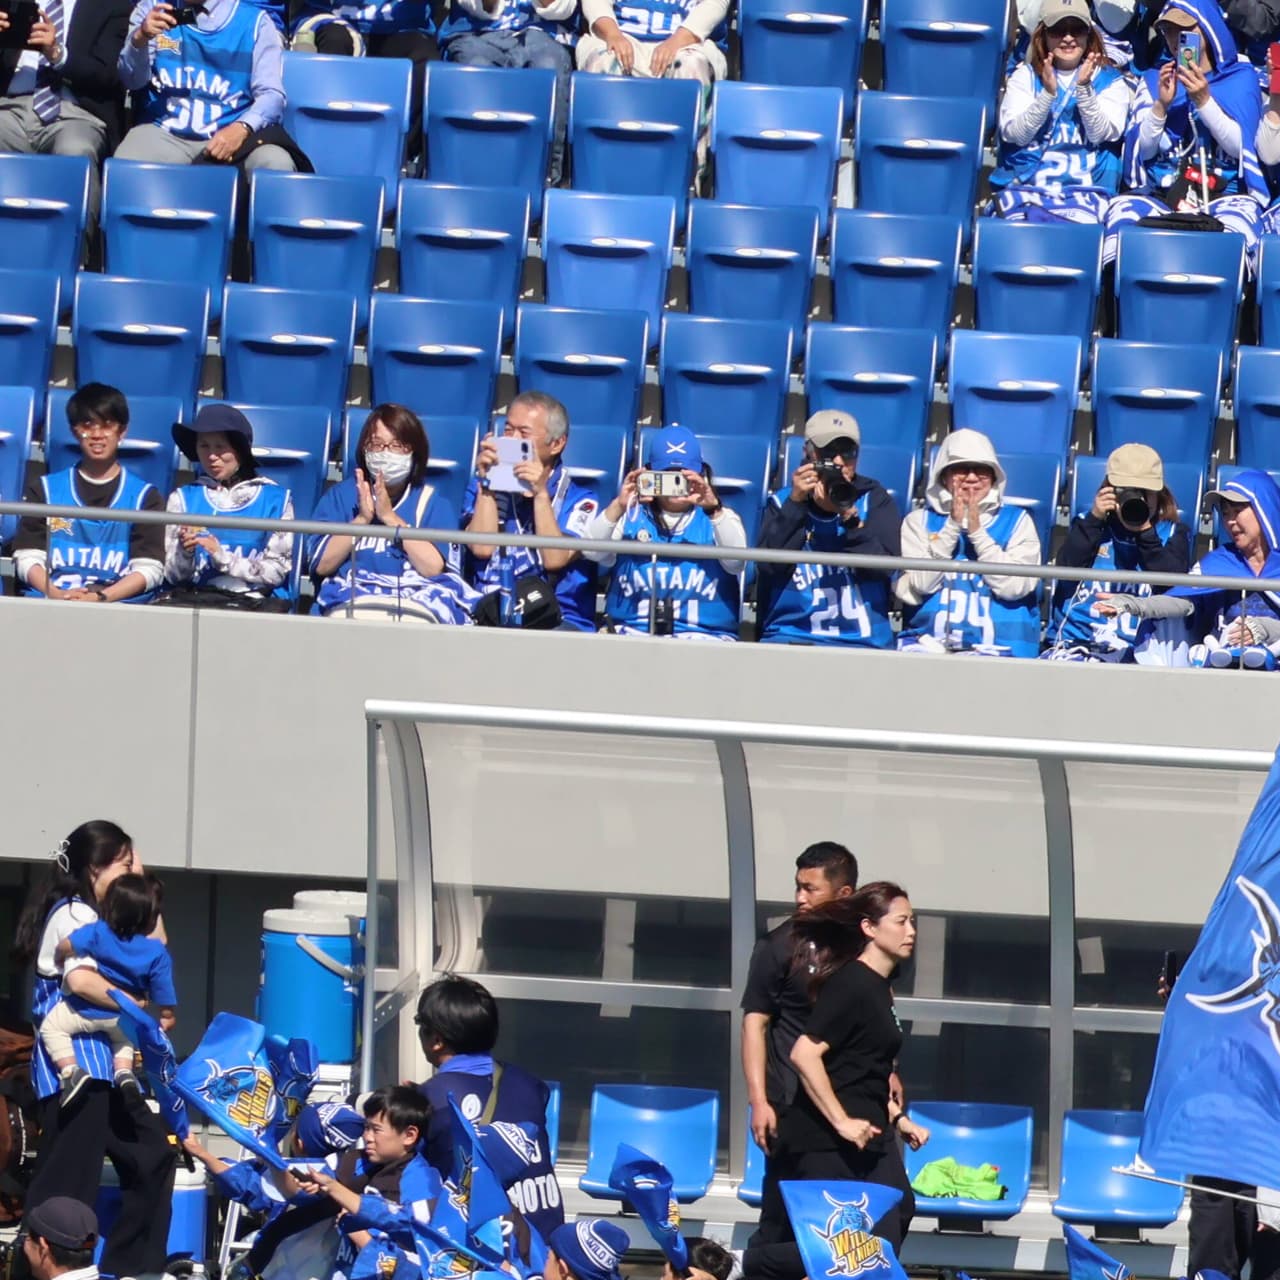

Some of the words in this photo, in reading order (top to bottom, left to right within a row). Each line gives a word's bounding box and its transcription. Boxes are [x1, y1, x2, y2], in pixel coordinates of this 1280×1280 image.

[1035, 151, 1096, 193] 24
[51, 546, 125, 573] AITAM
[810, 586, 872, 638] 24
[934, 588, 994, 649] 24
